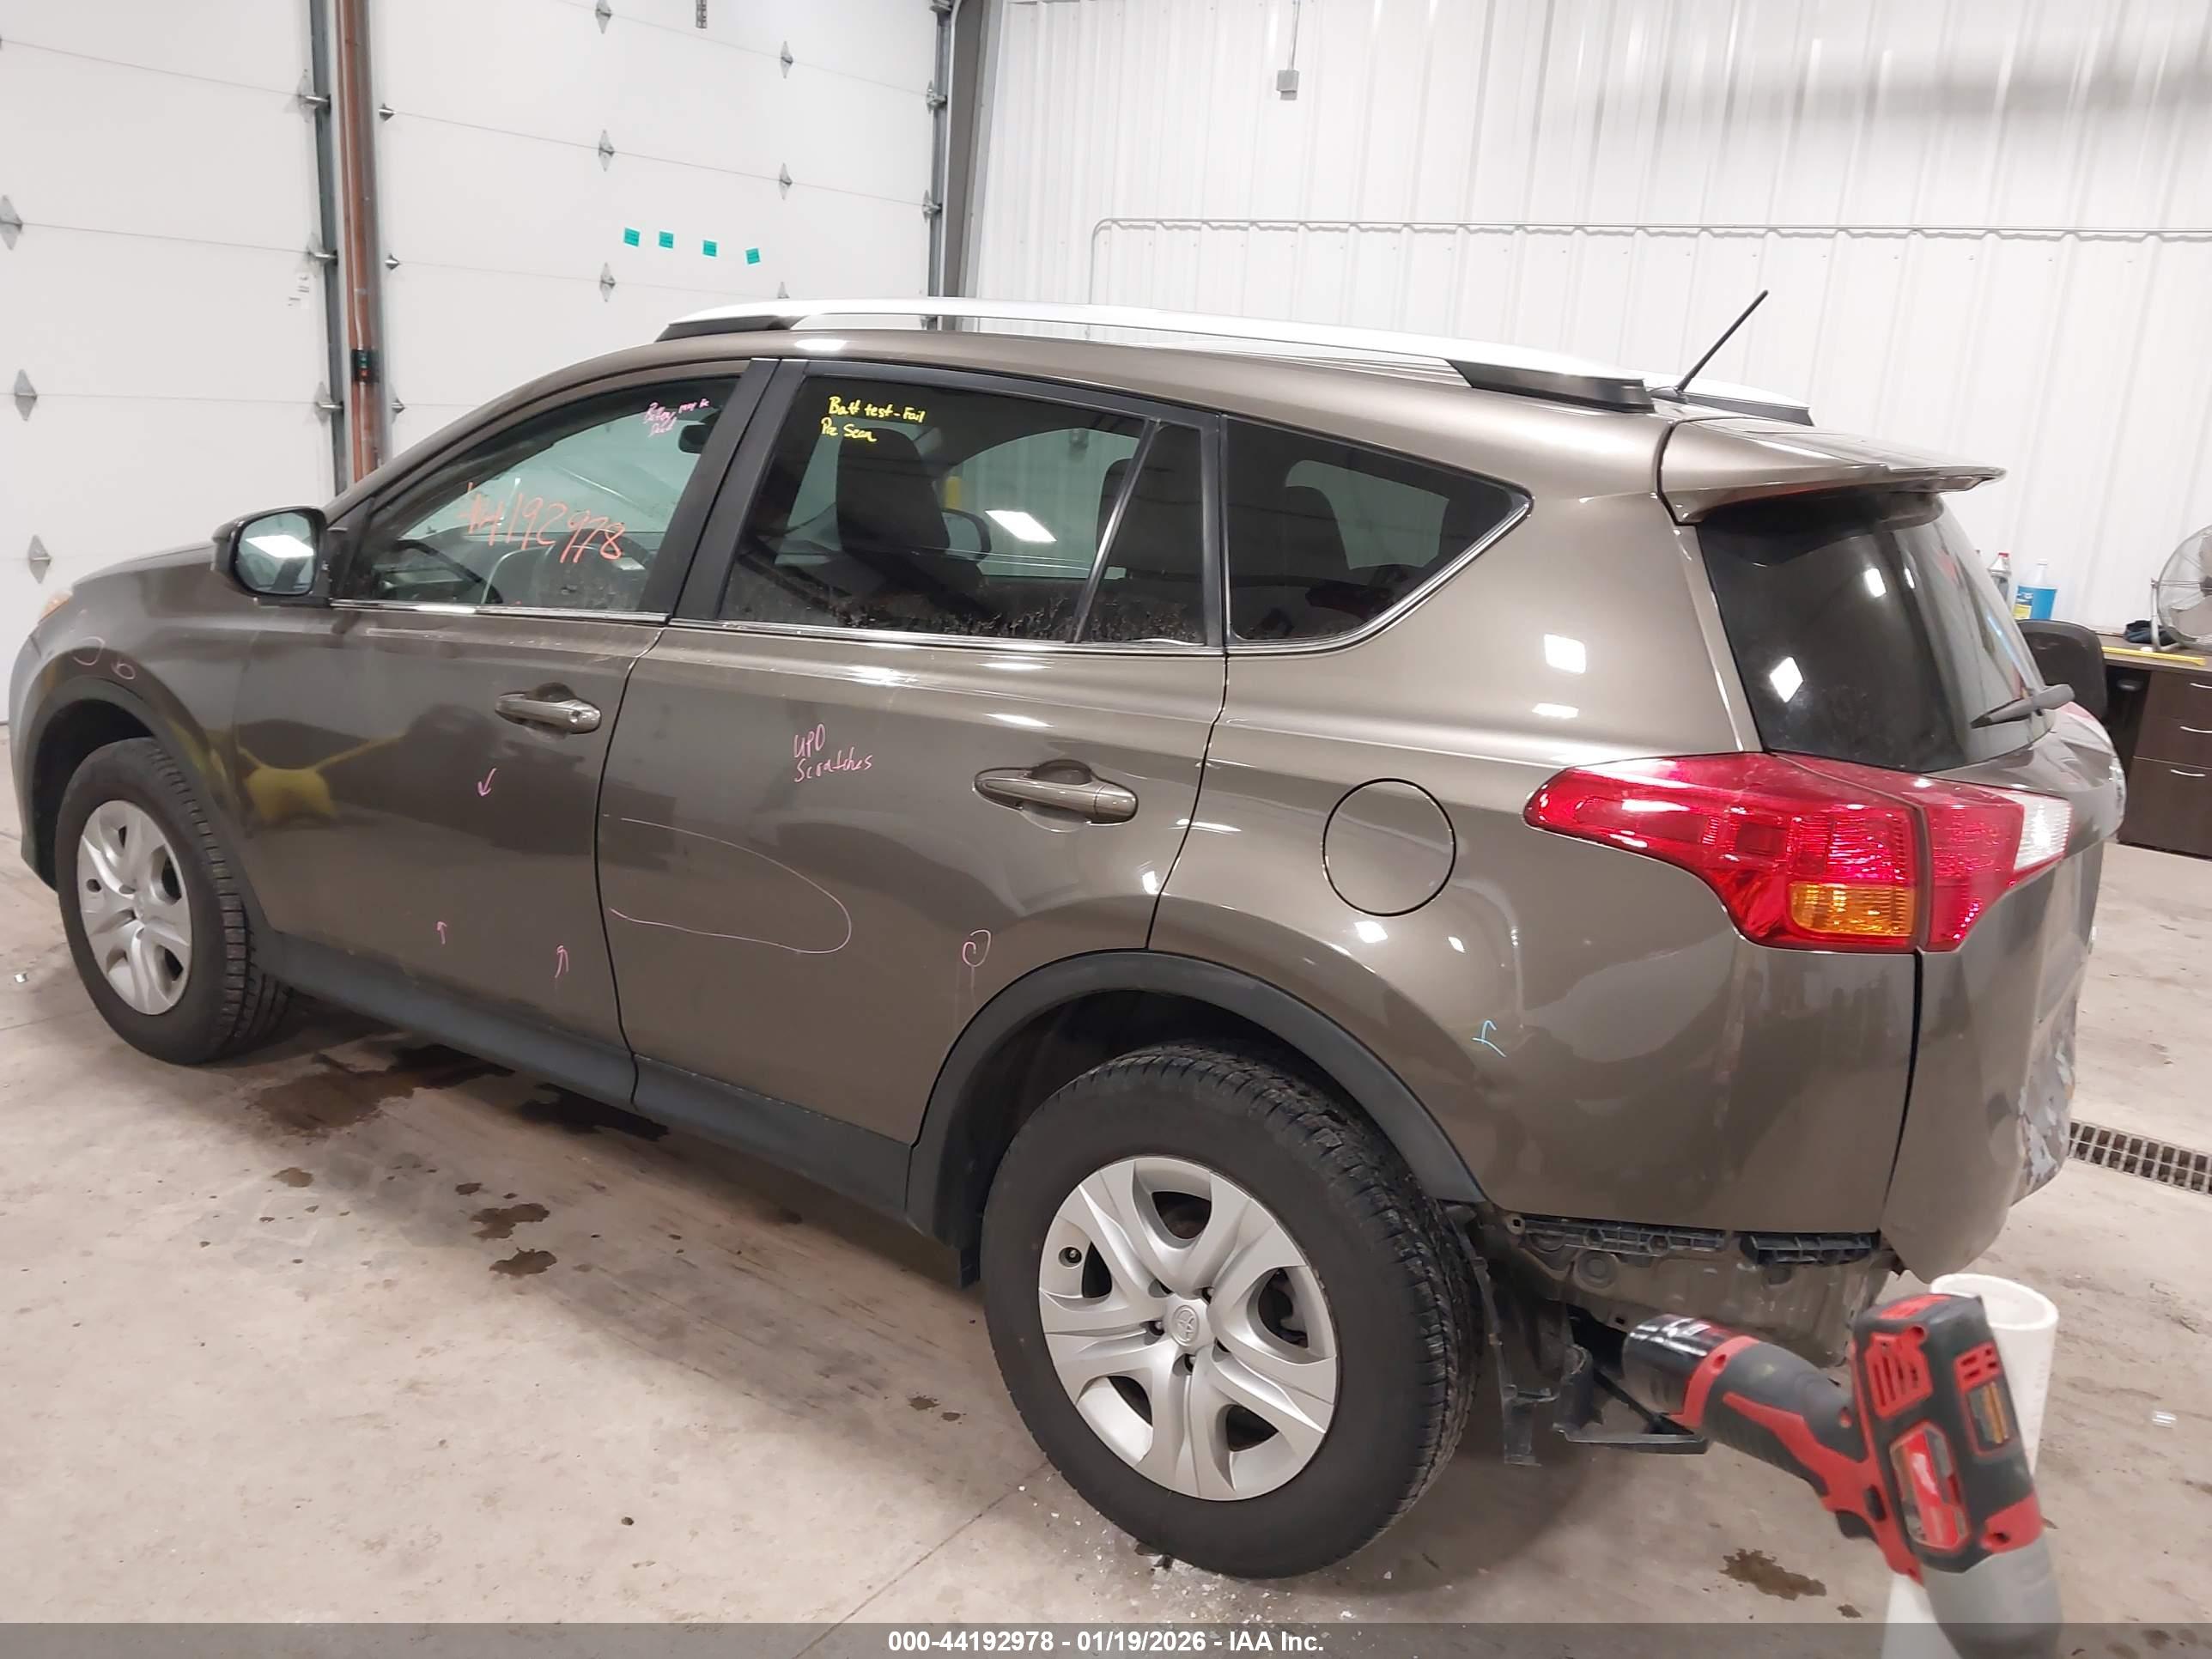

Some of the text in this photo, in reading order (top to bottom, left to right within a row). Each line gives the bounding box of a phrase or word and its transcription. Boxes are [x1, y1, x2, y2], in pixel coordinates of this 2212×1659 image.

[829, 395, 861, 416] Batt
[457, 481, 626, 564] 44192978
[793, 745, 873, 783] Scratches
